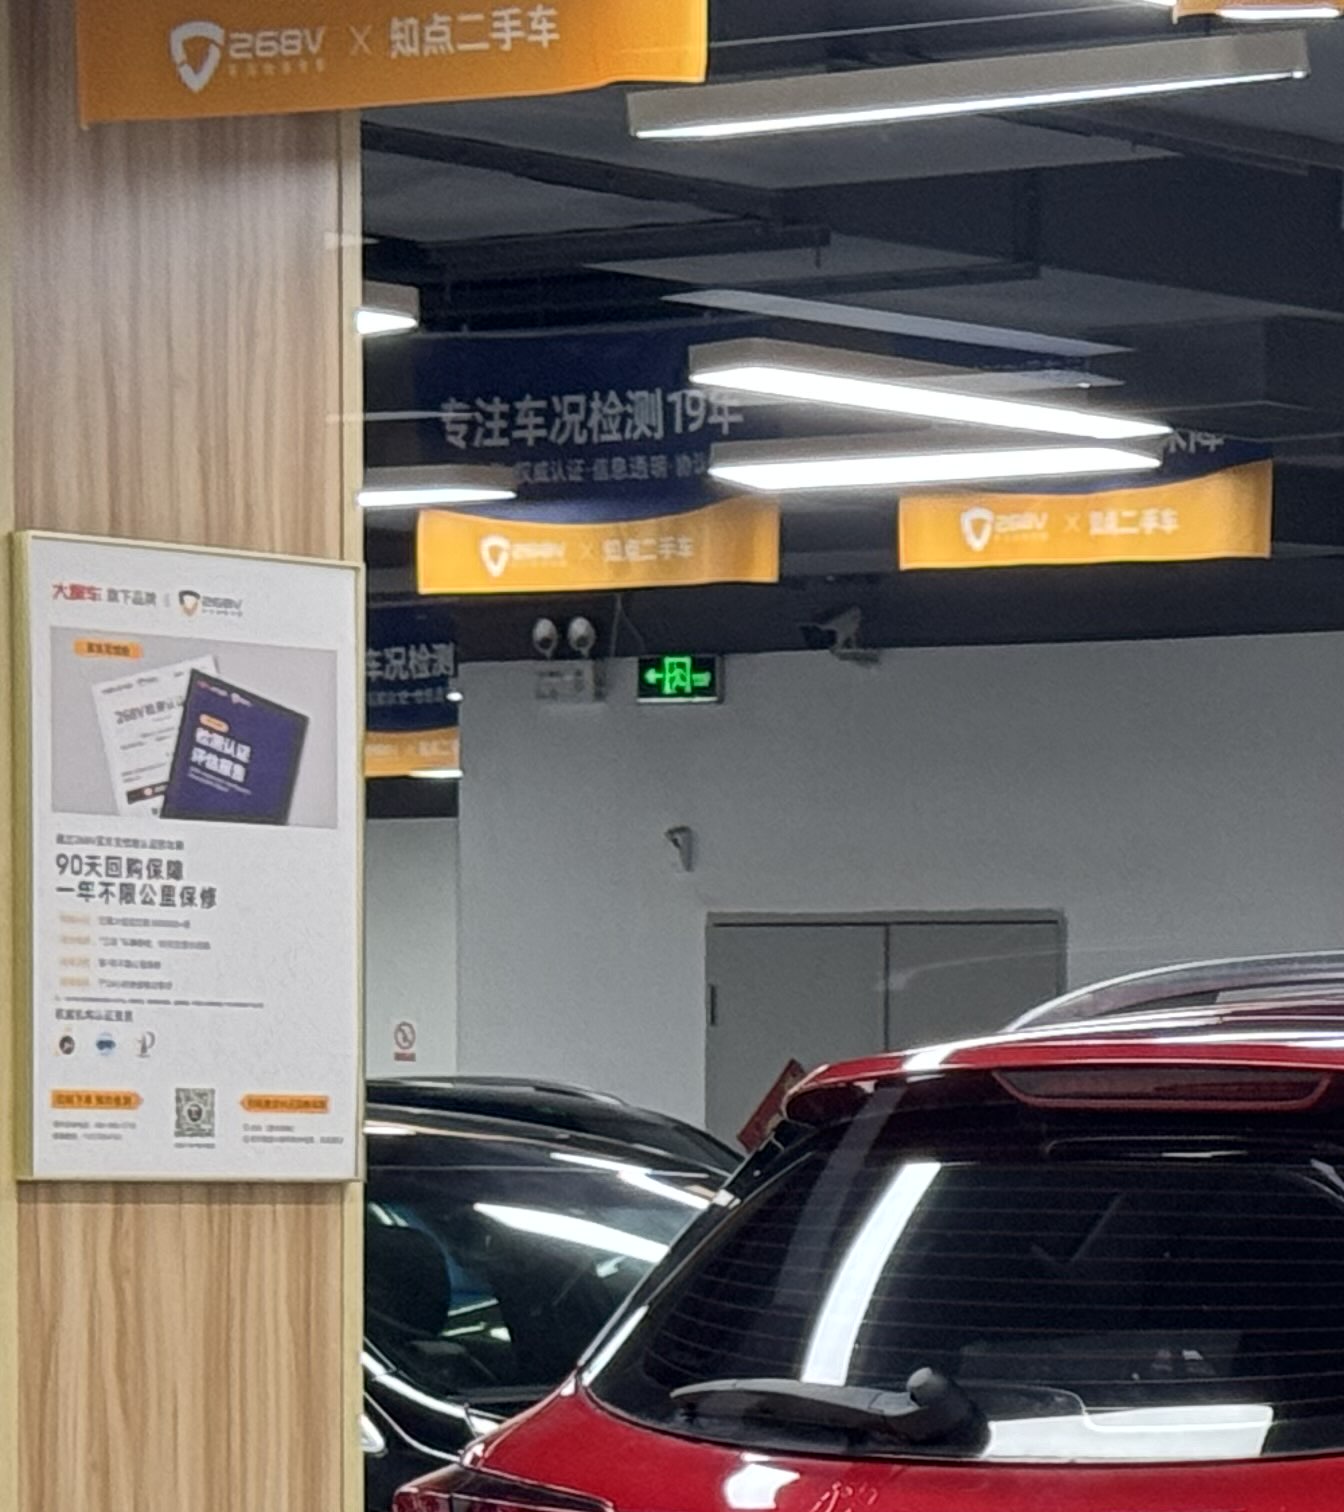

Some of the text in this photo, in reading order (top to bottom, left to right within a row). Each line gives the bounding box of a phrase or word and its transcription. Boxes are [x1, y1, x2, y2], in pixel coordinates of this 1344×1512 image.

[228, 27, 325, 60] 268V
[389, 4, 561, 60] 知点二手车
[440, 387, 745, 449] 专注车况检测19年
[55, 853, 184, 881] 90天回购保障
[55, 880, 218, 909] 一年不限公里保修
